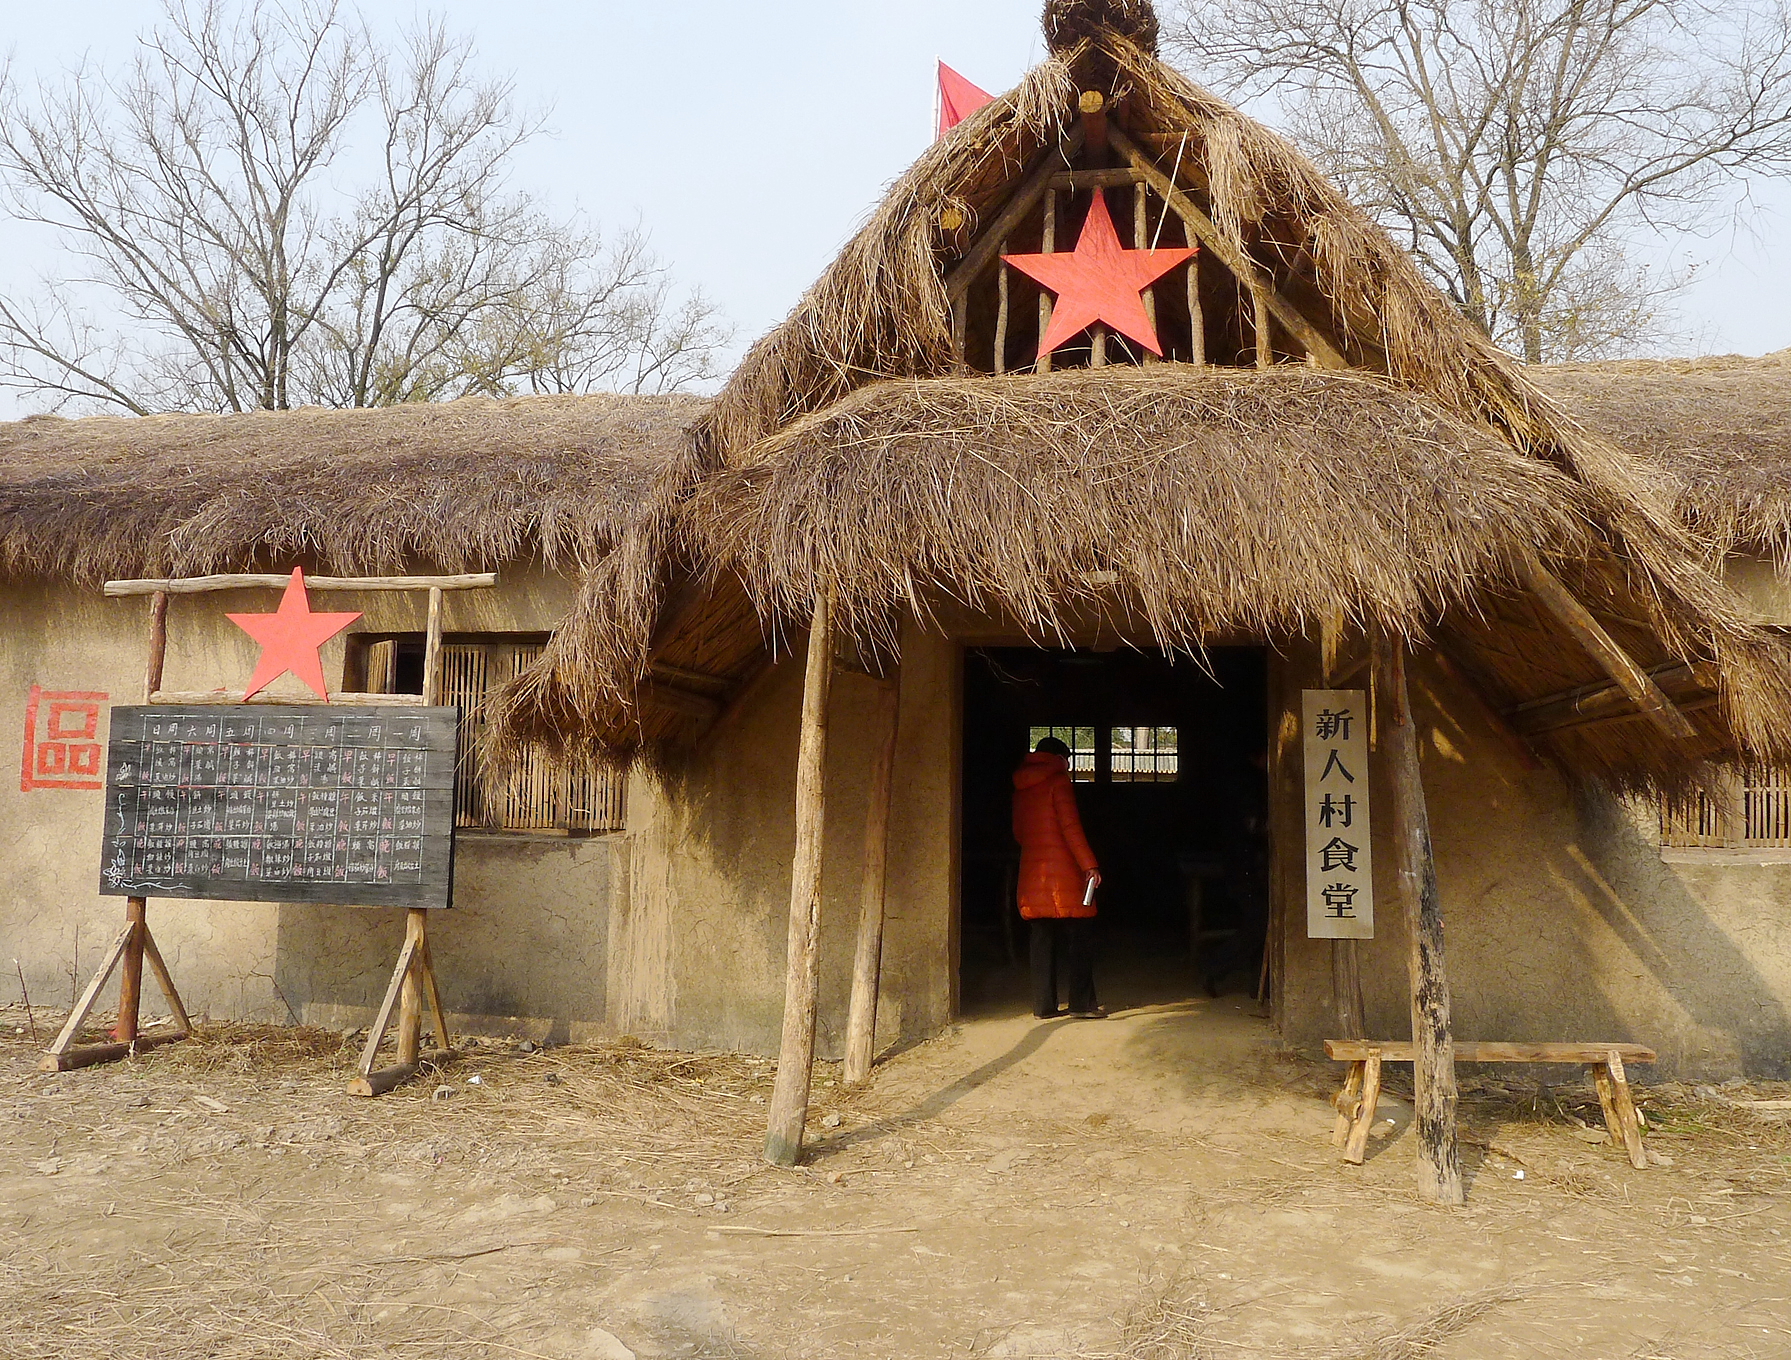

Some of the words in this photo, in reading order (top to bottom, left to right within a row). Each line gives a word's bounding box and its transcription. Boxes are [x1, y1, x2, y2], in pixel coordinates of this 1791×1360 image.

[1316, 708, 1359, 919] 新人村食堂
